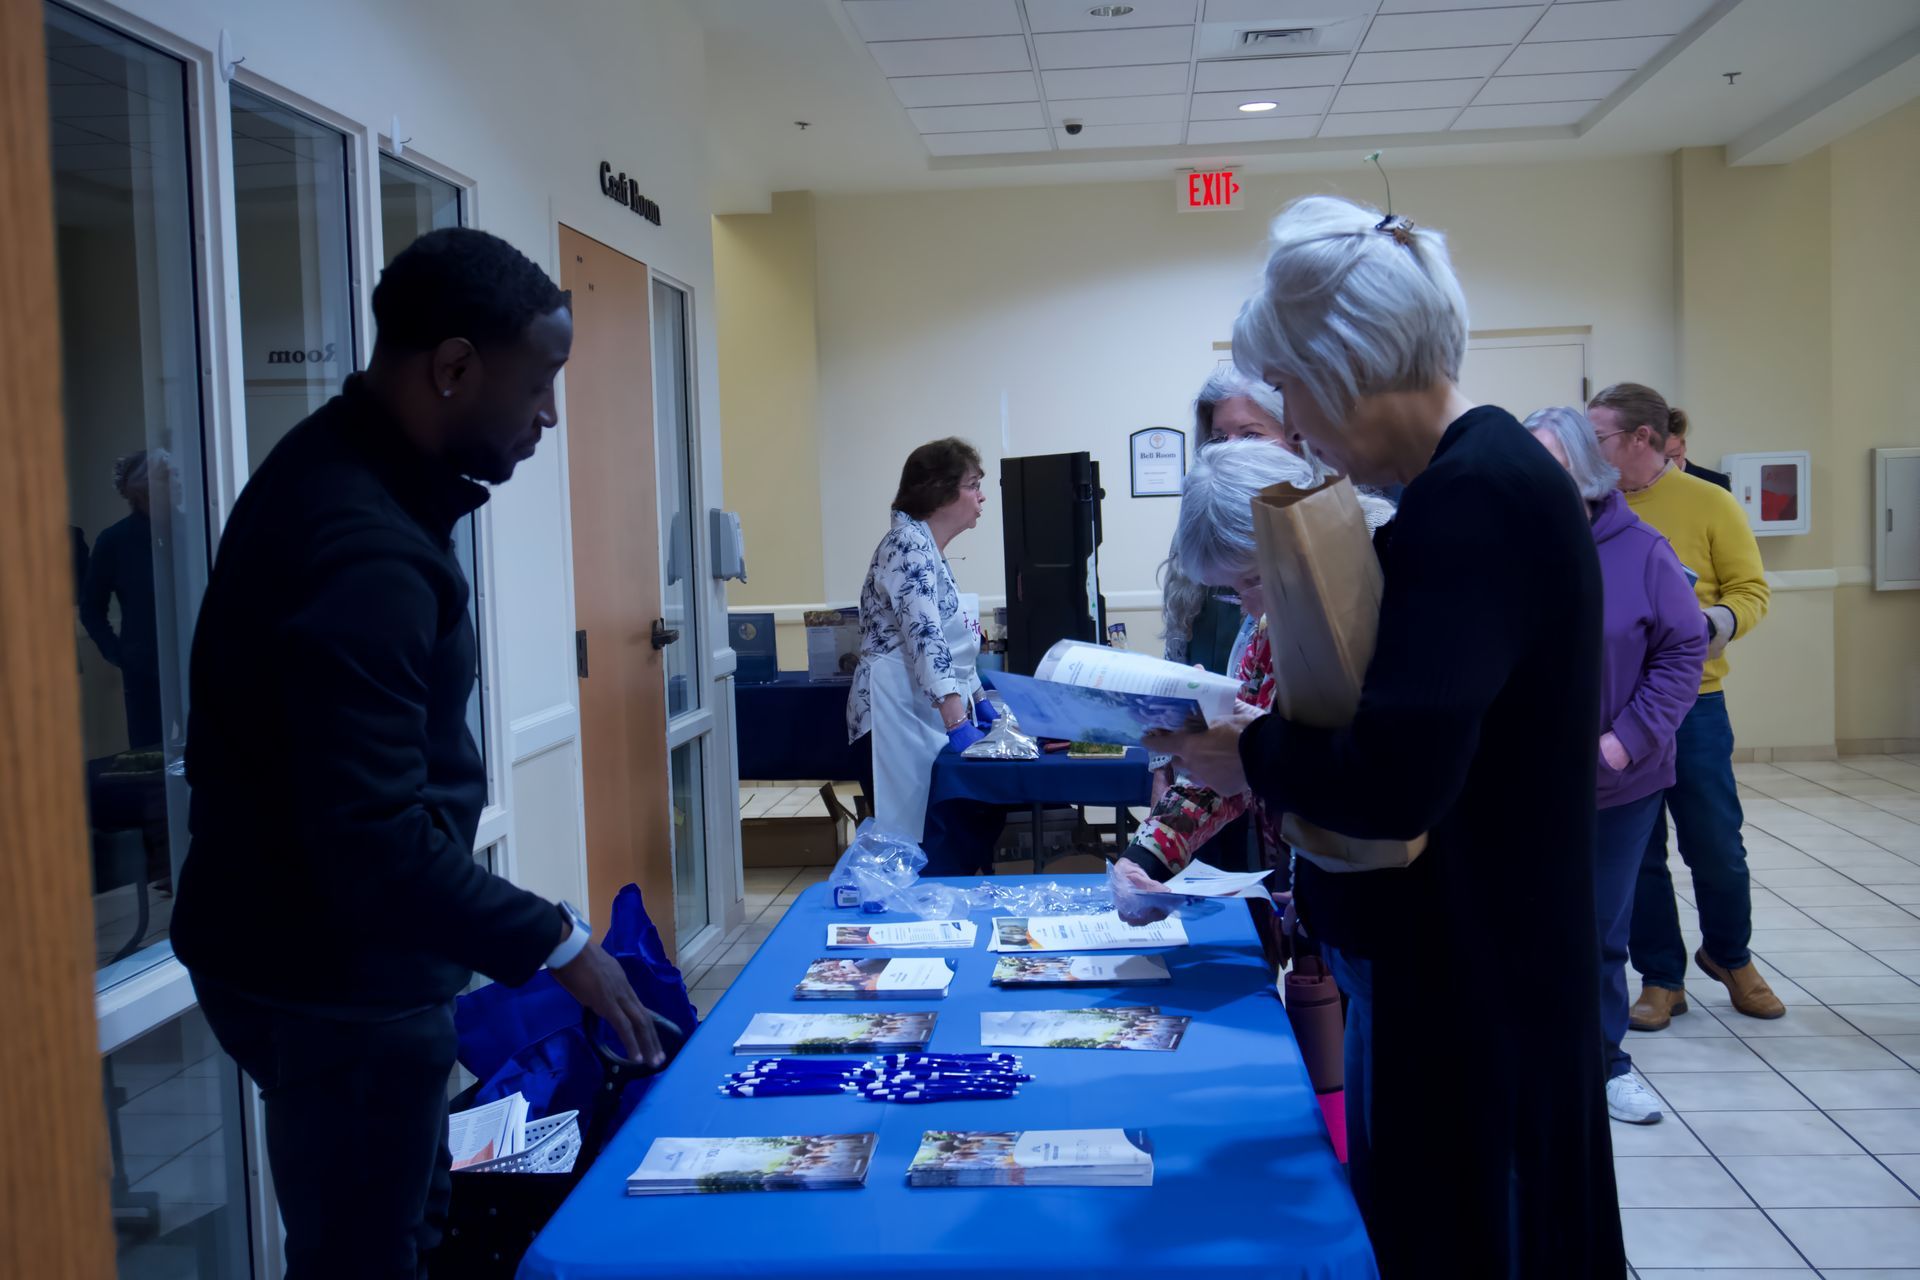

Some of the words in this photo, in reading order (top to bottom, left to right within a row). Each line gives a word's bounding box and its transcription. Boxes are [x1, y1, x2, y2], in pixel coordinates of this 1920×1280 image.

[629, 178, 661, 226] Room
[1189, 172, 1233, 206] EXIT
[1155, 451, 1177, 460] Room
